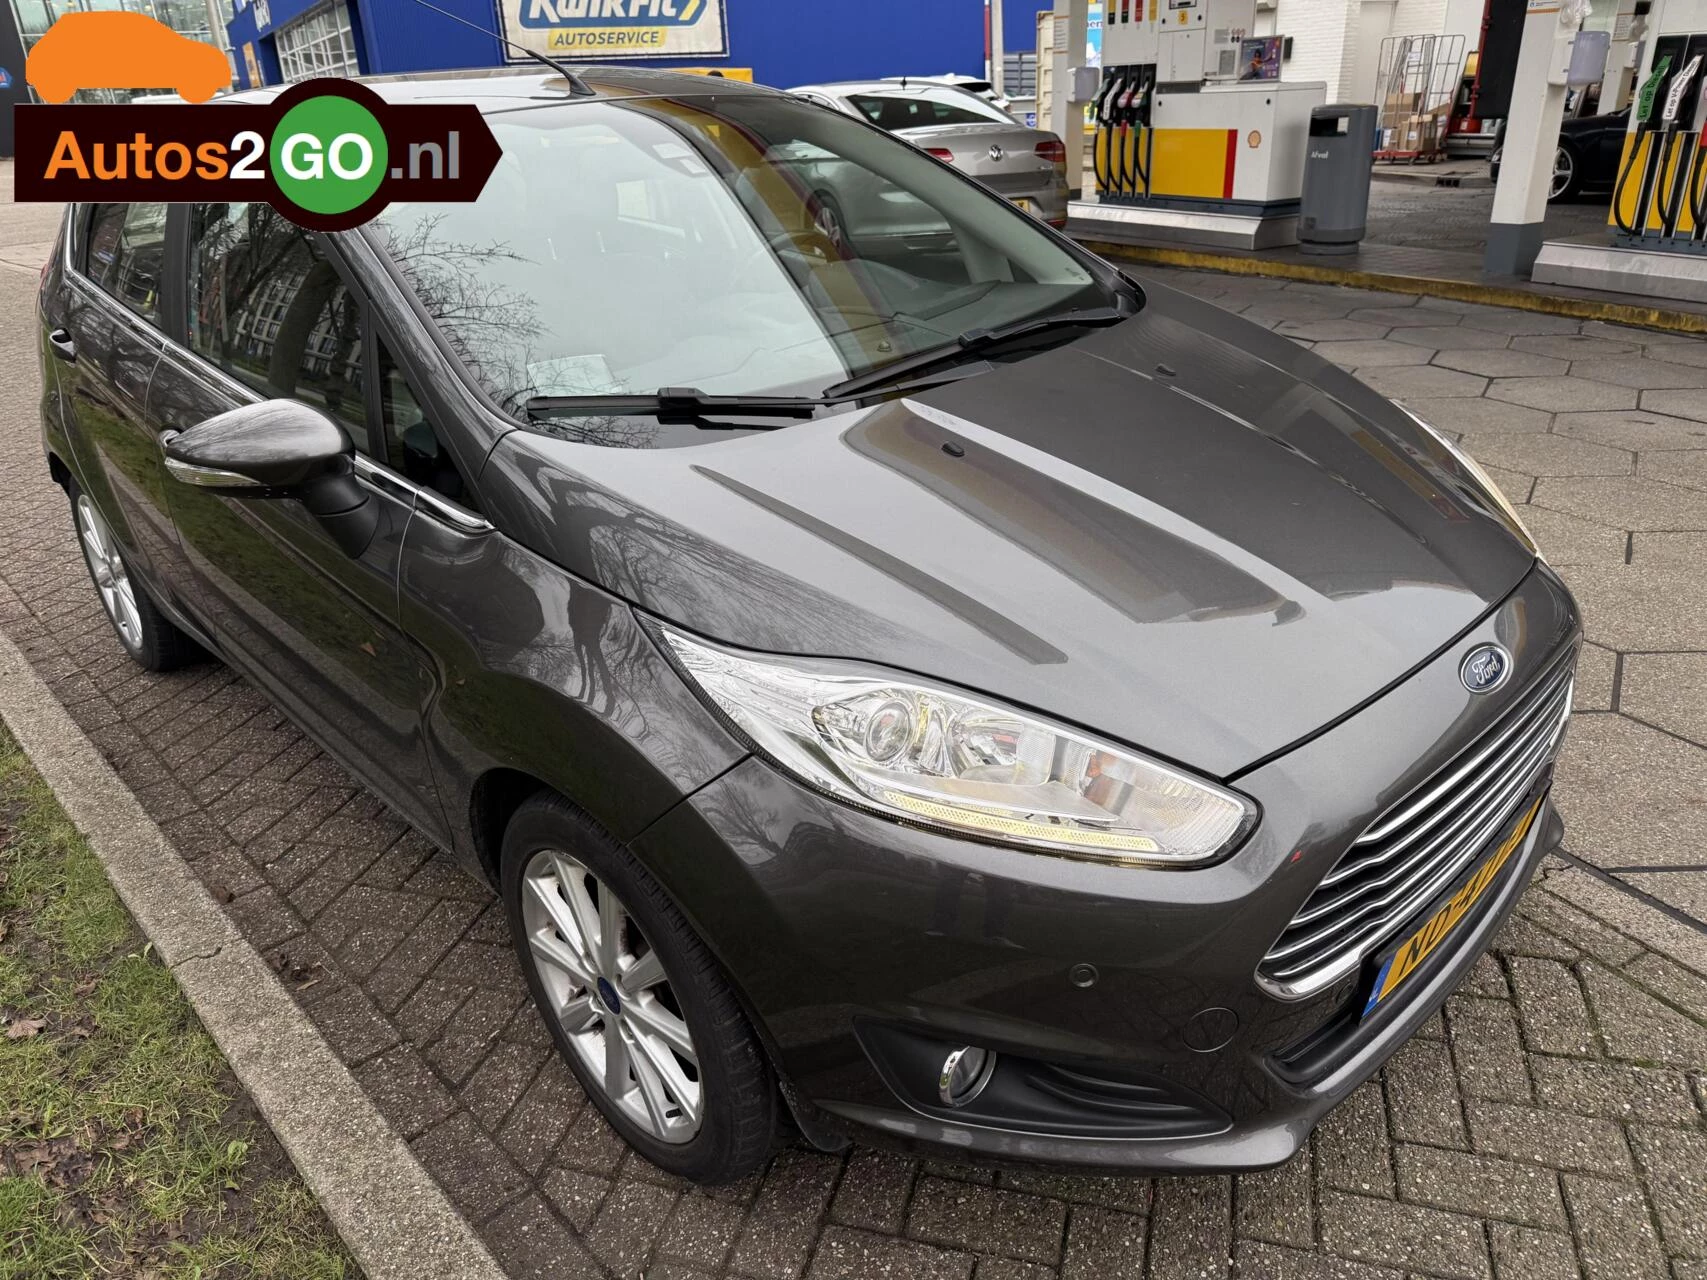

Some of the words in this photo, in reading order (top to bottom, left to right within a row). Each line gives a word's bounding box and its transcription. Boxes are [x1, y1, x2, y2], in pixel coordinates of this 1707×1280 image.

[554, 30, 660, 47] AUTOSERVICE
[1644, 90, 1653, 102] op
[1669, 98, 1677, 107] op
[1665, 107, 1674, 118] Let
[1310, 150, 1329, 159] Afval
[1471, 655, 1501, 685] Ford
